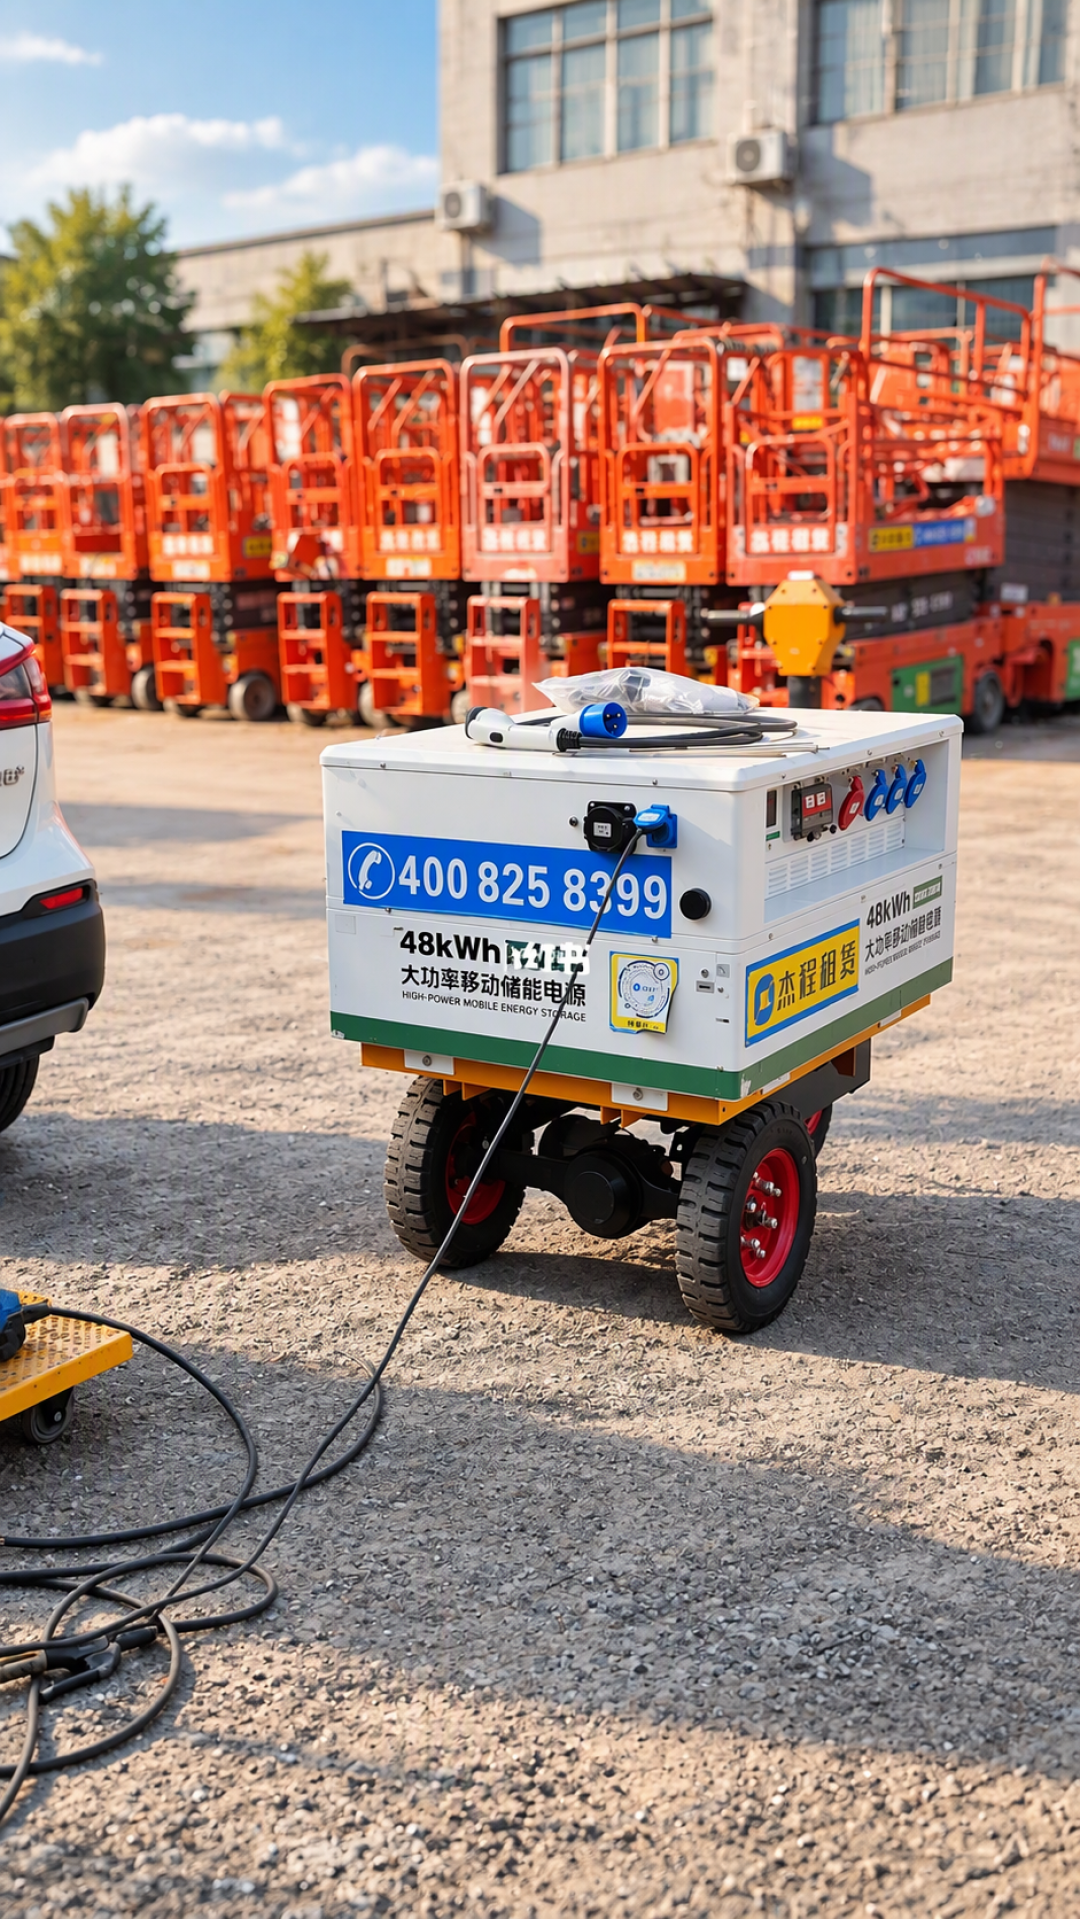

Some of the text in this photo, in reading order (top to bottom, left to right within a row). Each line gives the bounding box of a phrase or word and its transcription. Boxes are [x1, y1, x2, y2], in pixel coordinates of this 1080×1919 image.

[399, 855, 668, 920] 400 825 8399
[866, 890, 911, 929] 48kWh
[400, 930, 501, 964] 48kWh
[401, 964, 587, 1007] 大功率移动储能电源
[777, 940, 856, 1011] 杰程租赁
[402, 990, 587, 1022] HIGH-POWER MOBILE ENERGY STORAGE
